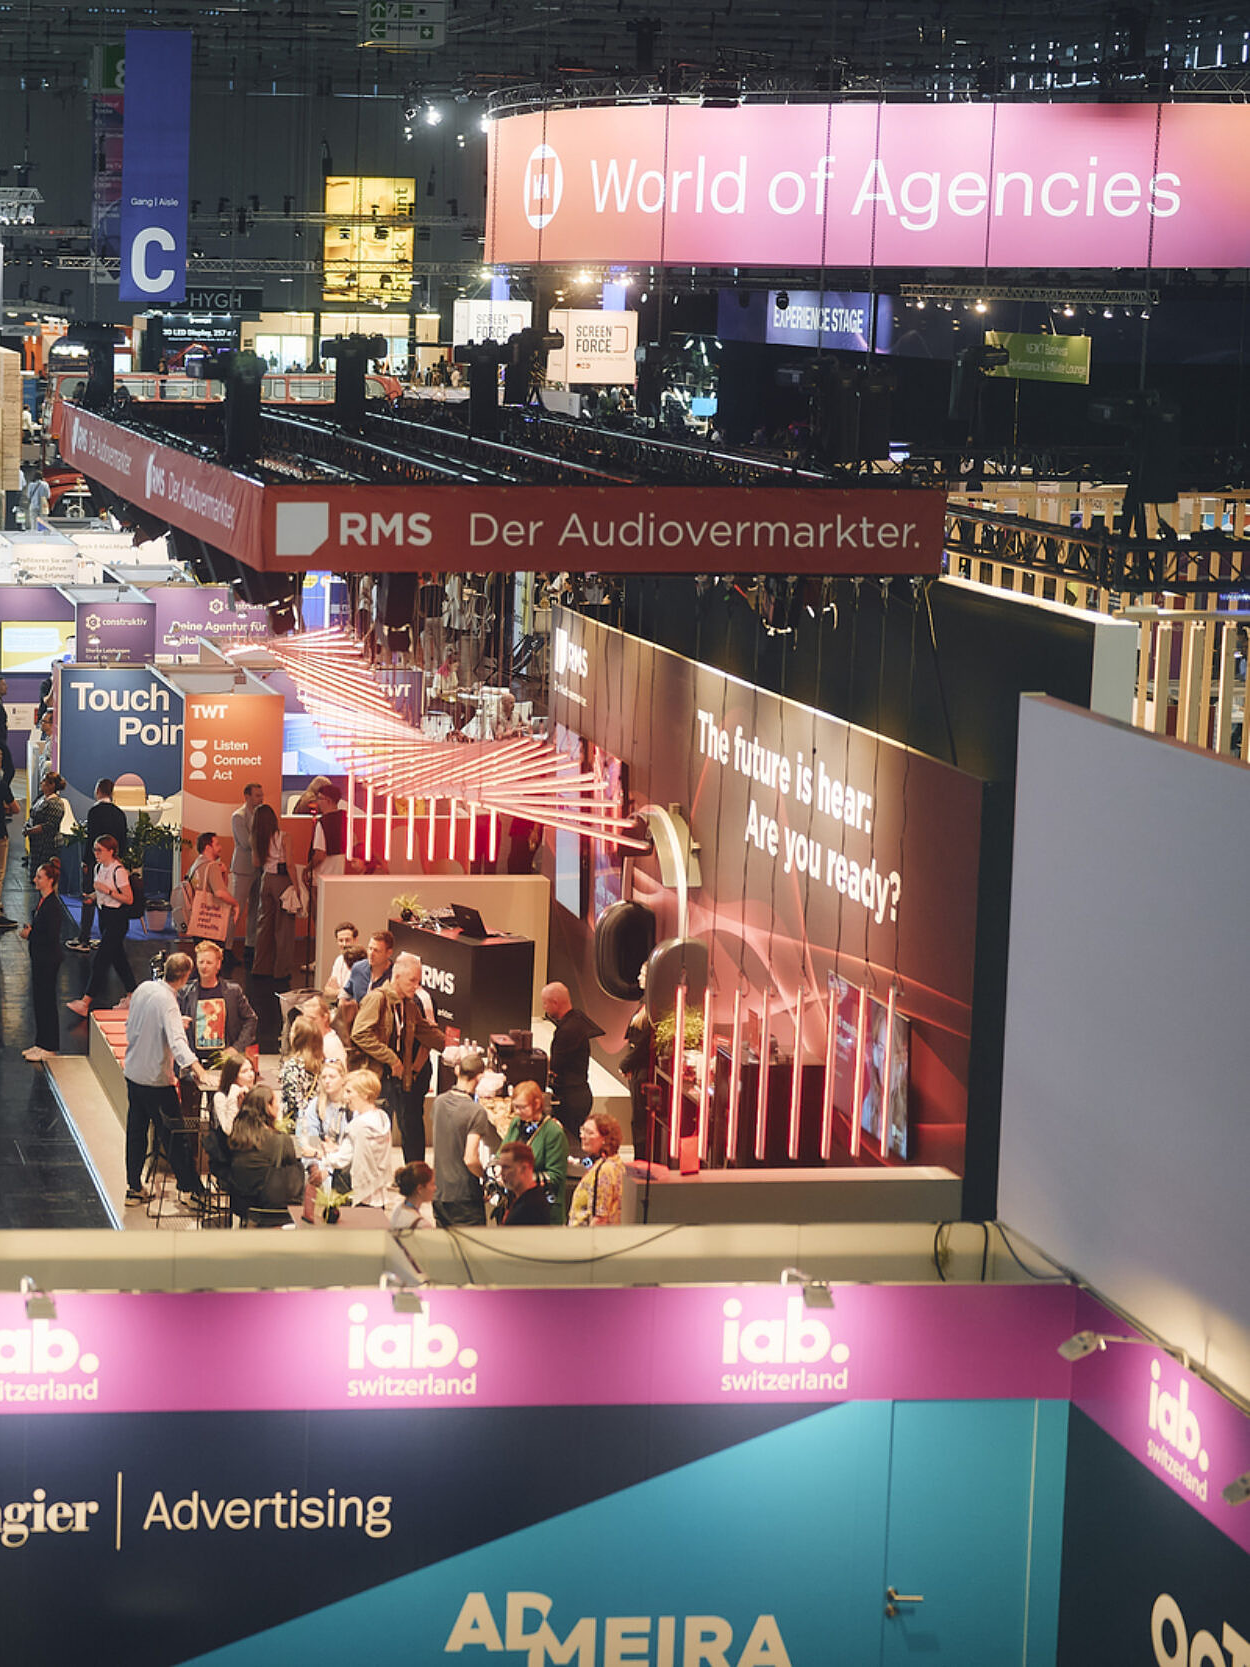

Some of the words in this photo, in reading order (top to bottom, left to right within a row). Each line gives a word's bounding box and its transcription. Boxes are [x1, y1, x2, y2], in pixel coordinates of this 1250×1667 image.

[130, 197, 154, 208] Gang
[158, 197, 179, 207] Aisle
[590, 155, 748, 214] World
[768, 155, 835, 215] of
[851, 157, 1182, 231] Agencies
[131, 226, 176, 293] C
[189, 293, 242, 308] HYGH
[173, 328, 186, 336] LED
[476, 314, 509, 325] SCREEN
[476, 326, 508, 339] FORCE
[576, 326, 612, 338] SCREEN
[773, 305, 831, 332] EXPERIENCE
[831, 307, 865, 334] STAGE
[576, 339, 612, 353] FORCE
[339, 512, 433, 546] RMS
[470, 512, 544, 546] Der
[557, 512, 921, 549] Audiovermarkter.
[102, 616, 148, 627] construktiv
[172, 621, 203, 632] Deine
[204, 620, 248, 633] Agentur
[250, 620, 267, 632] für
[568, 642, 588, 679] RMS
[70, 682, 170, 711] Touch
[379, 683, 412, 698] TWT
[190, 704, 229, 719] TWT
[118, 716, 183, 746] Poin
[213, 739, 249, 751] Listen
[213, 754, 262, 766] Connect
[698, 709, 729, 766] The
[734, 725, 791, 794] future
[796, 751, 812, 806] is
[817, 761, 873, 835] hear:
[212, 770, 233, 780] Act
[745, 799, 779, 857] Are
[784, 826, 822, 881] you
[827, 848, 901, 925] ready?
[421, 964, 455, 995] RMS
[347, 1301, 479, 1370] iab.
[722, 1297, 851, 1365] iab.
[347, 1373, 477, 1397] switzerland
[721, 1366, 849, 1392] switzerland
[1148, 1358, 1210, 1473] iab.
[1147, 1437, 1208, 1502] switzerland
[143, 1488, 392, 1538] Advertising
[443, 1591, 794, 1667] ADMEIRA
